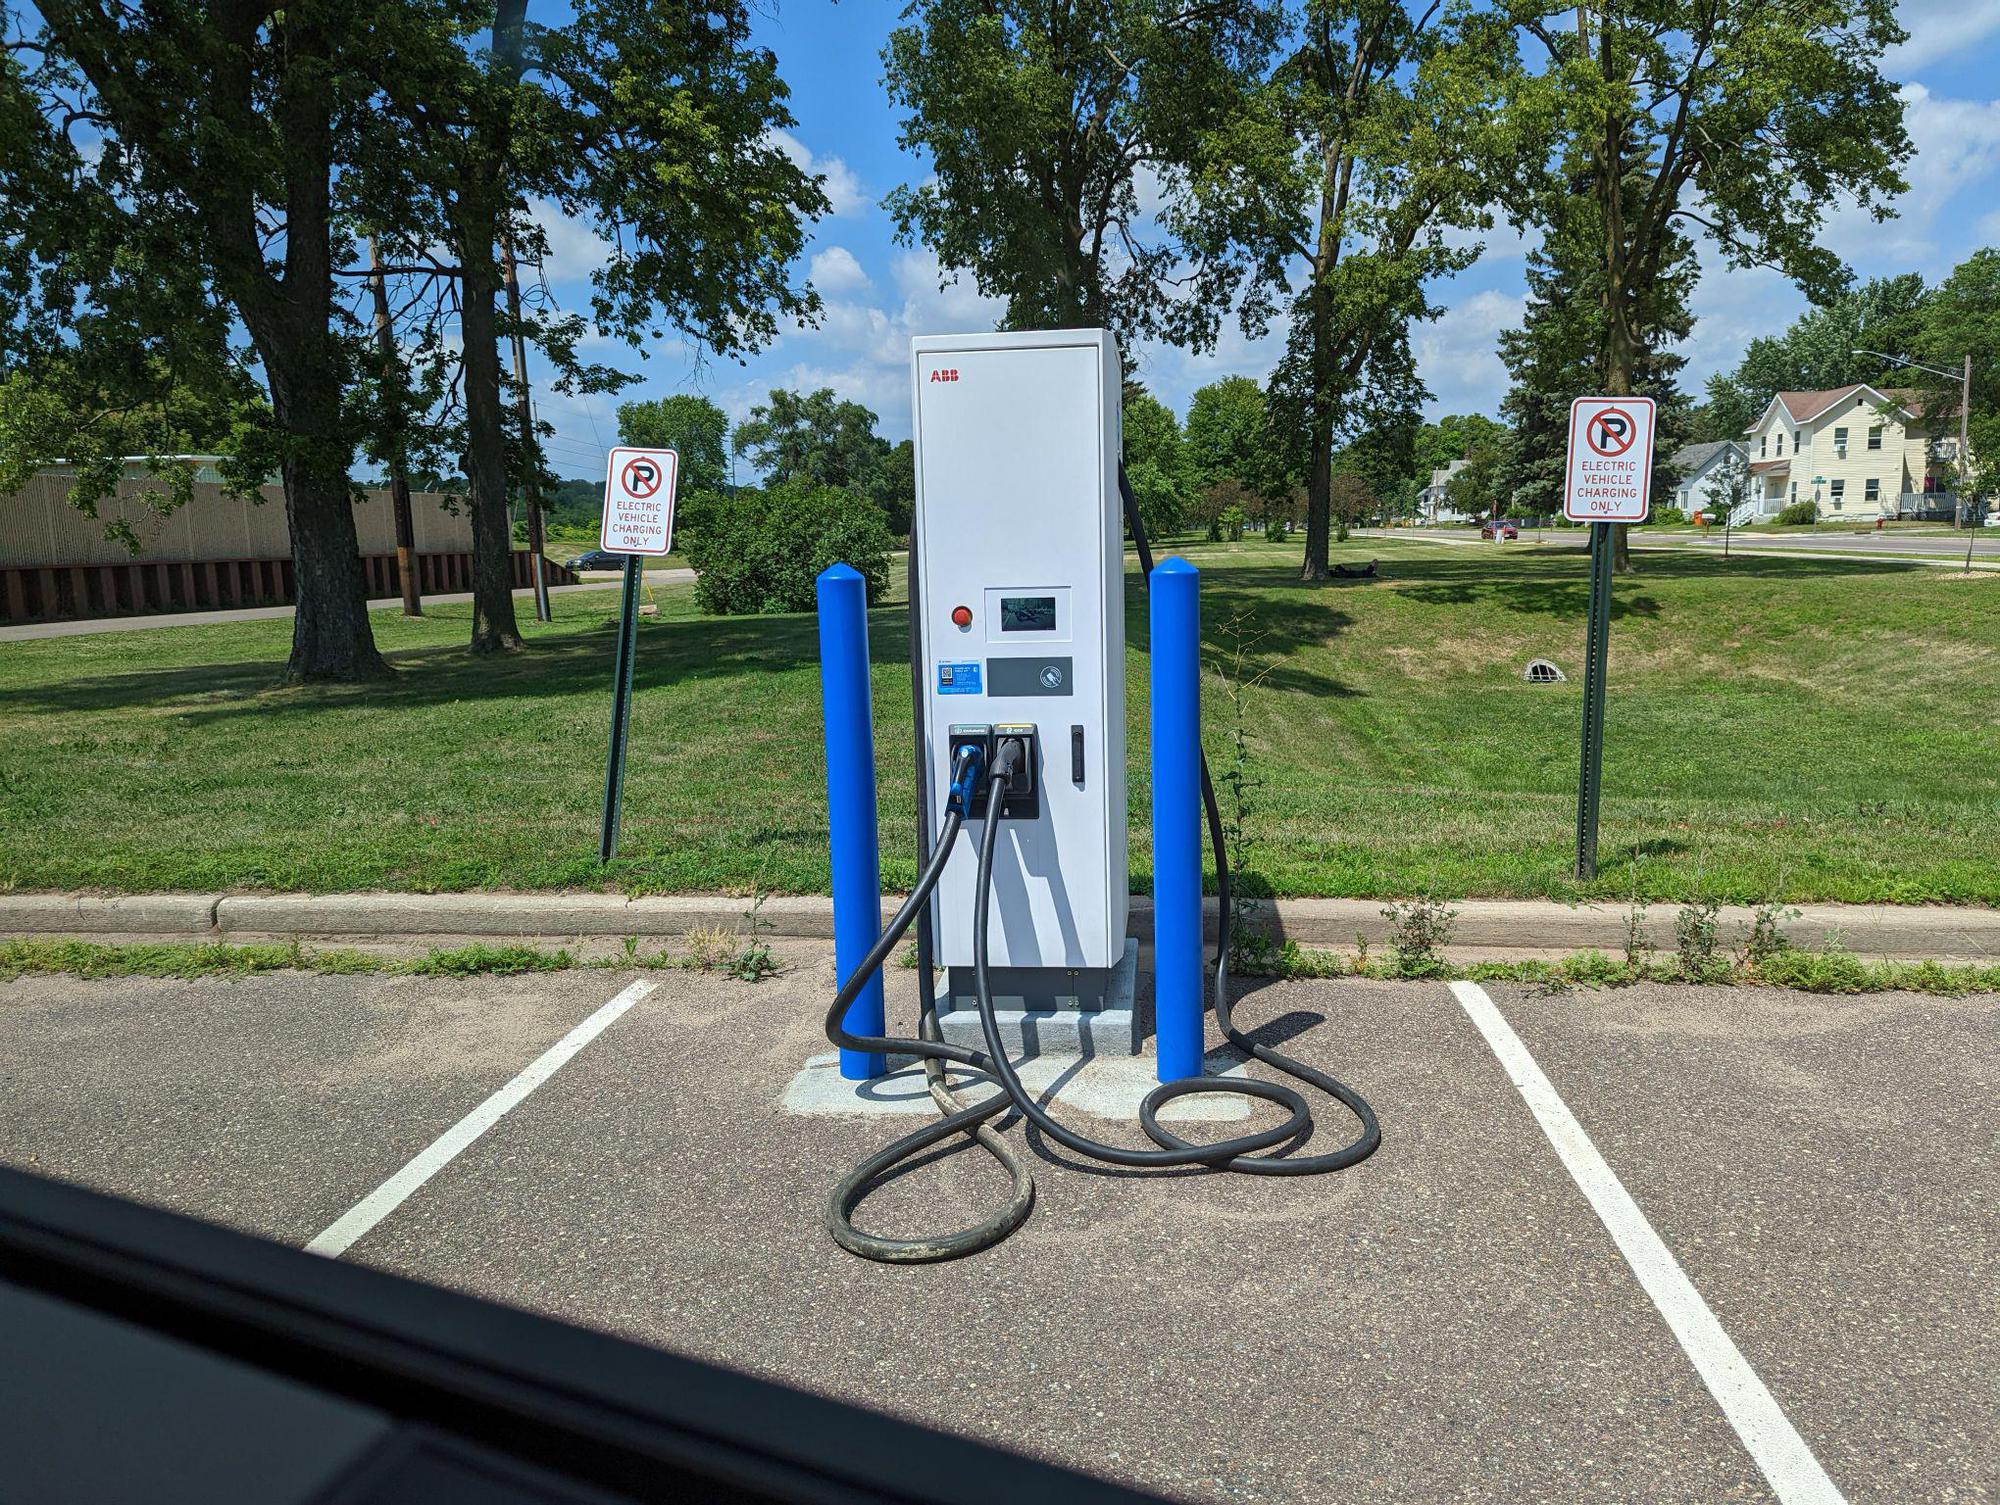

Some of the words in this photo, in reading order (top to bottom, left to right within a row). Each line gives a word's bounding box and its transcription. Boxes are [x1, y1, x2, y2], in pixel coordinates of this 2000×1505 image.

[930, 369, 959, 382] ABB
[1581, 461, 1636, 471] ELECTRIC
[1584, 474, 1632, 485] VEHICLE
[1577, 487, 1637, 498] CHARGING
[616, 501, 662, 512] ELECTRIC
[1590, 501, 1622, 511] ONLY
[618, 513, 658, 523] VEHICLE
[612, 523, 662, 535] CHARGING
[623, 536, 649, 546] ONLY
